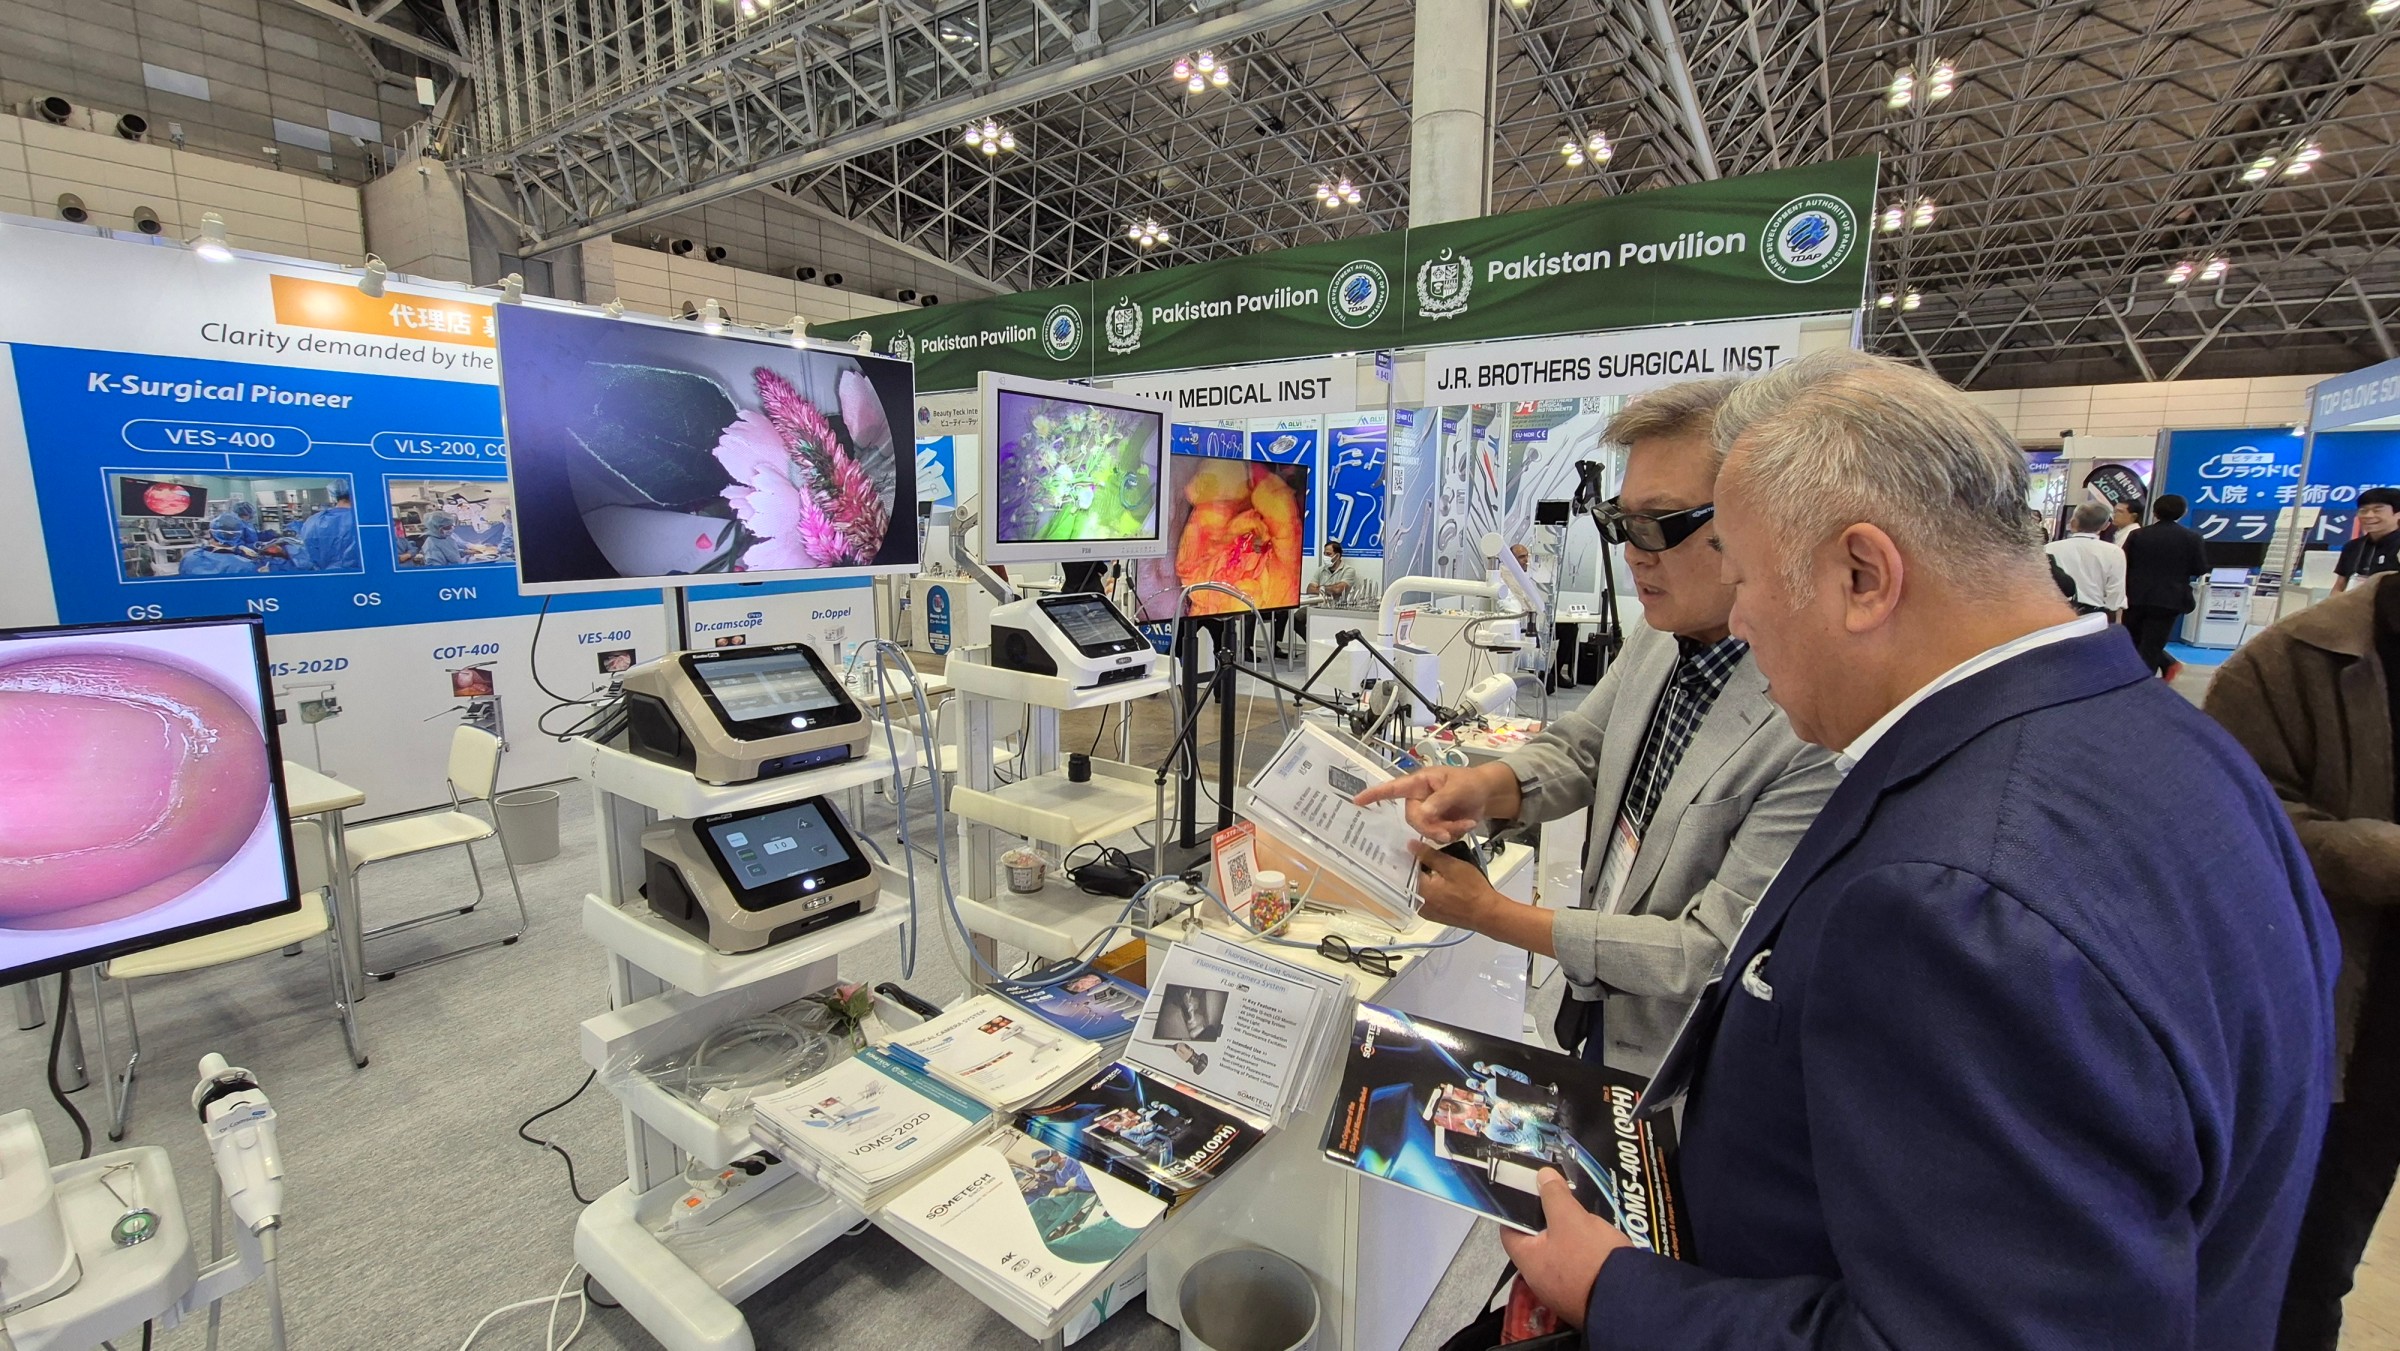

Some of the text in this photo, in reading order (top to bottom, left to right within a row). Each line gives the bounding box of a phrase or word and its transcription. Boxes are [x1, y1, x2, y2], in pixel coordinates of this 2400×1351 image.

[1766, 199, 1851, 275] TRADE DEVELOPMENT AUTHORITY OF PAKISTAN
[1487, 229, 1746, 283] Pakistan Pavilion
[1791, 253, 1822, 263] TDAP
[389, 303, 472, 336] 代理店
[1151, 286, 1318, 325] Pakistan Pavilion
[200, 322, 494, 370] Clarity demanded by the
[921, 325, 1037, 354] Pakistan Pavilion
[1437, 345, 1781, 391] J.R. BROTHERS SURGICAL INST
[87, 371, 353, 409] K-Surgical Pioneer
[1179, 382, 1272, 409] MEDICAL
[1278, 377, 1331, 402] INST
[2320, 391, 2341, 416] TOP
[2341, 381, 2379, 412] GLOVE
[933, 410, 952, 418] Beauty
[953, 408, 965, 416] Teck
[164, 428, 276, 449] VES-400
[394, 439, 480, 459] VLS-200,
[2198, 513, 2348, 541] クラド
[247, 597, 280, 612] NS
[354, 592, 382, 607] OS
[439, 586, 477, 602] GYN
[127, 604, 163, 620] GS
[694, 617, 763, 633] Dr.camscope
[811, 607, 851, 620] Dr.Oppel
[433, 642, 500, 660] COT-400
[578, 629, 632, 645] VES-400
[1225, 948, 1264, 969] Fluorescence
[1196, 958, 1286, 992] Fluorescence Camera System
[906, 1009, 988, 1047] MEDICAL CAMERA SYSTEM
[1362, 1023, 1377, 1059] SOMETE
[1237, 1091, 1272, 1108] SOMETECH
[848, 1112, 931, 1156] VOMS-202D
[1203, 1125, 1236, 1153] (OPH)
[1611, 1085, 1650, 1249] VOMS-400 (OPH)
[926, 1173, 992, 1220] SOMETECH
[1001, 1252, 1017, 1265] 4K
